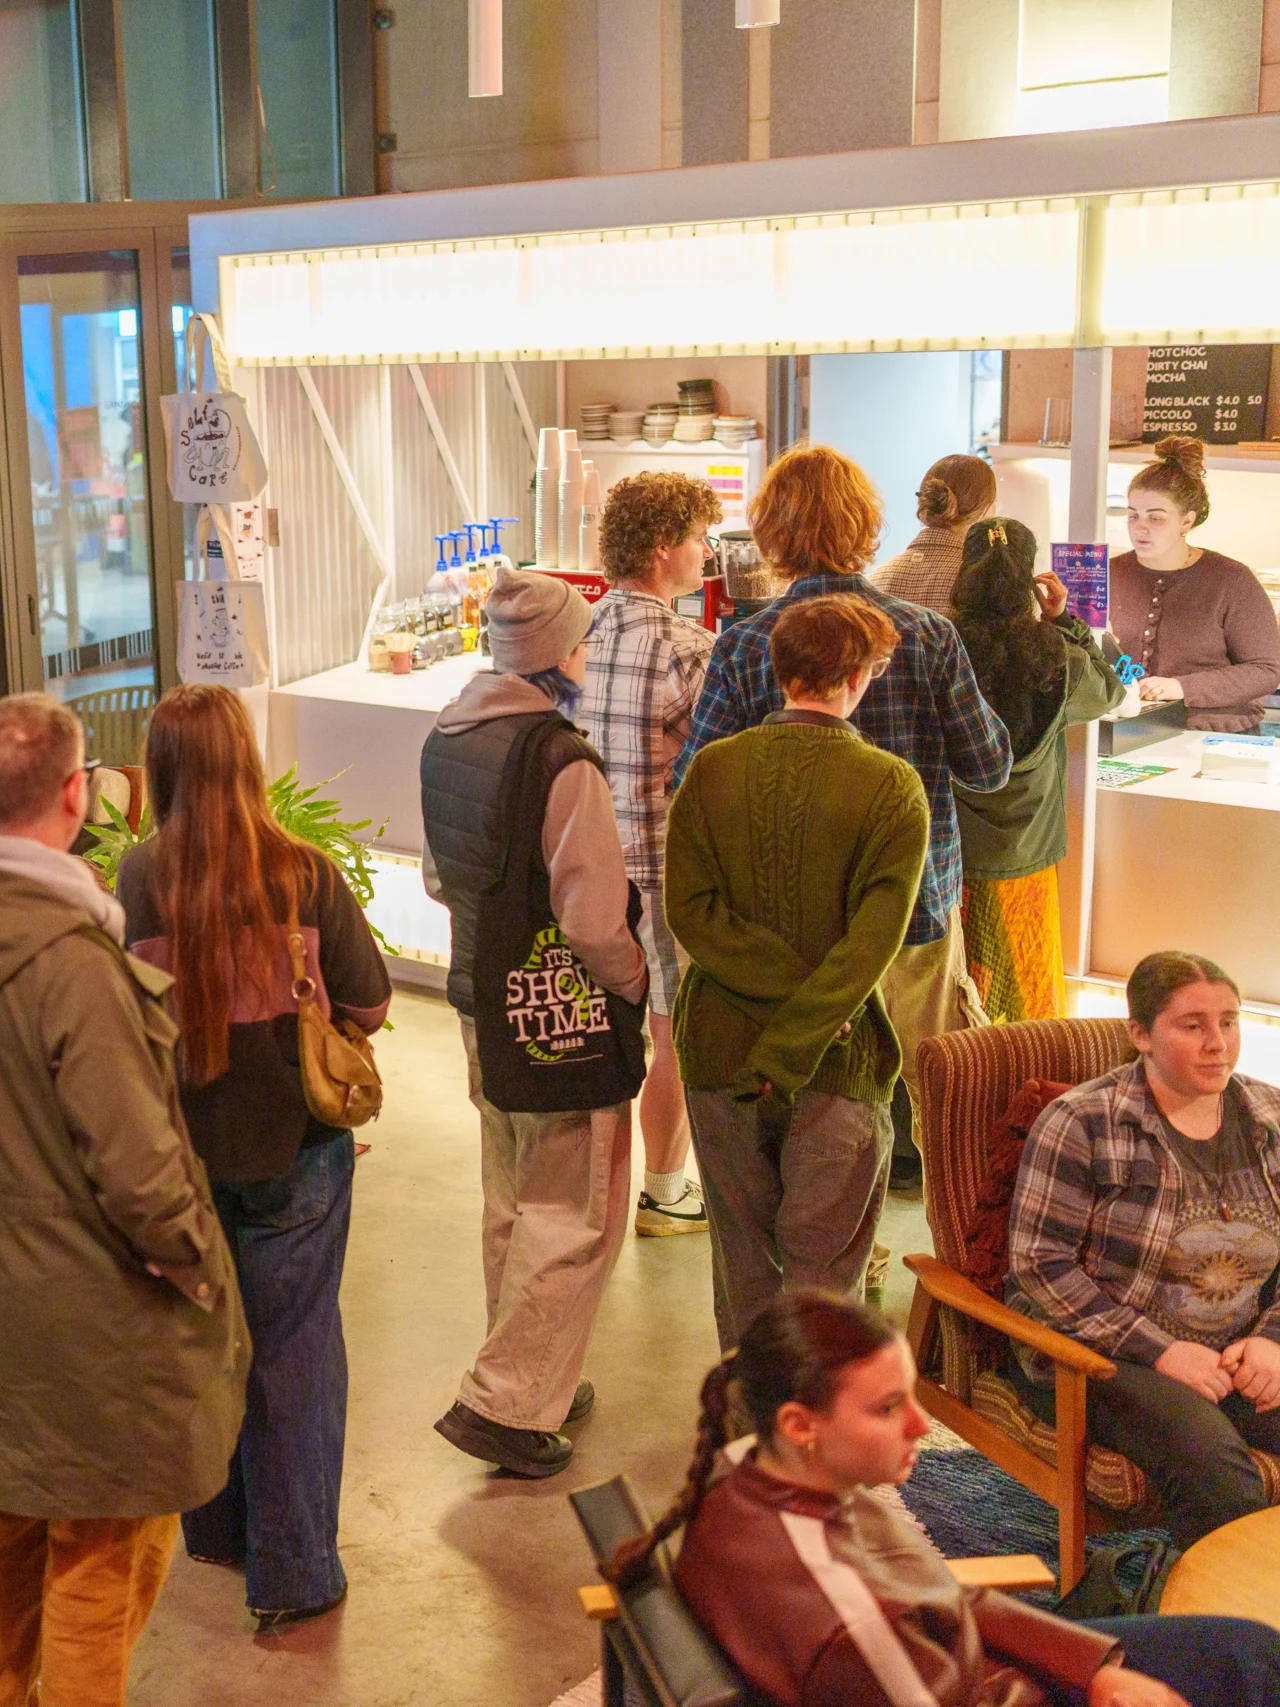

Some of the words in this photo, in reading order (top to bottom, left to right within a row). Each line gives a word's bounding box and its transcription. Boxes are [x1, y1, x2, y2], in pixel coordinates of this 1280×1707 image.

[1147, 361, 1179, 371] DIRTY
[1181, 360, 1208, 370] CHAI
[1146, 373, 1186, 383] MOCHA
[1144, 397, 1173, 407] LONG
[1173, 396, 1210, 406] BLACK
[1216, 395, 1240, 406] $4.0
[1247, 395, 1263, 405] 5.0
[1143, 410, 1192, 420] PICCOLO
[1215, 409, 1238, 419] $4.0
[1143, 422, 1197, 432] ESPRESSO
[1214, 421, 1237, 432] $3.0
[506, 997, 611, 1043] TIME
